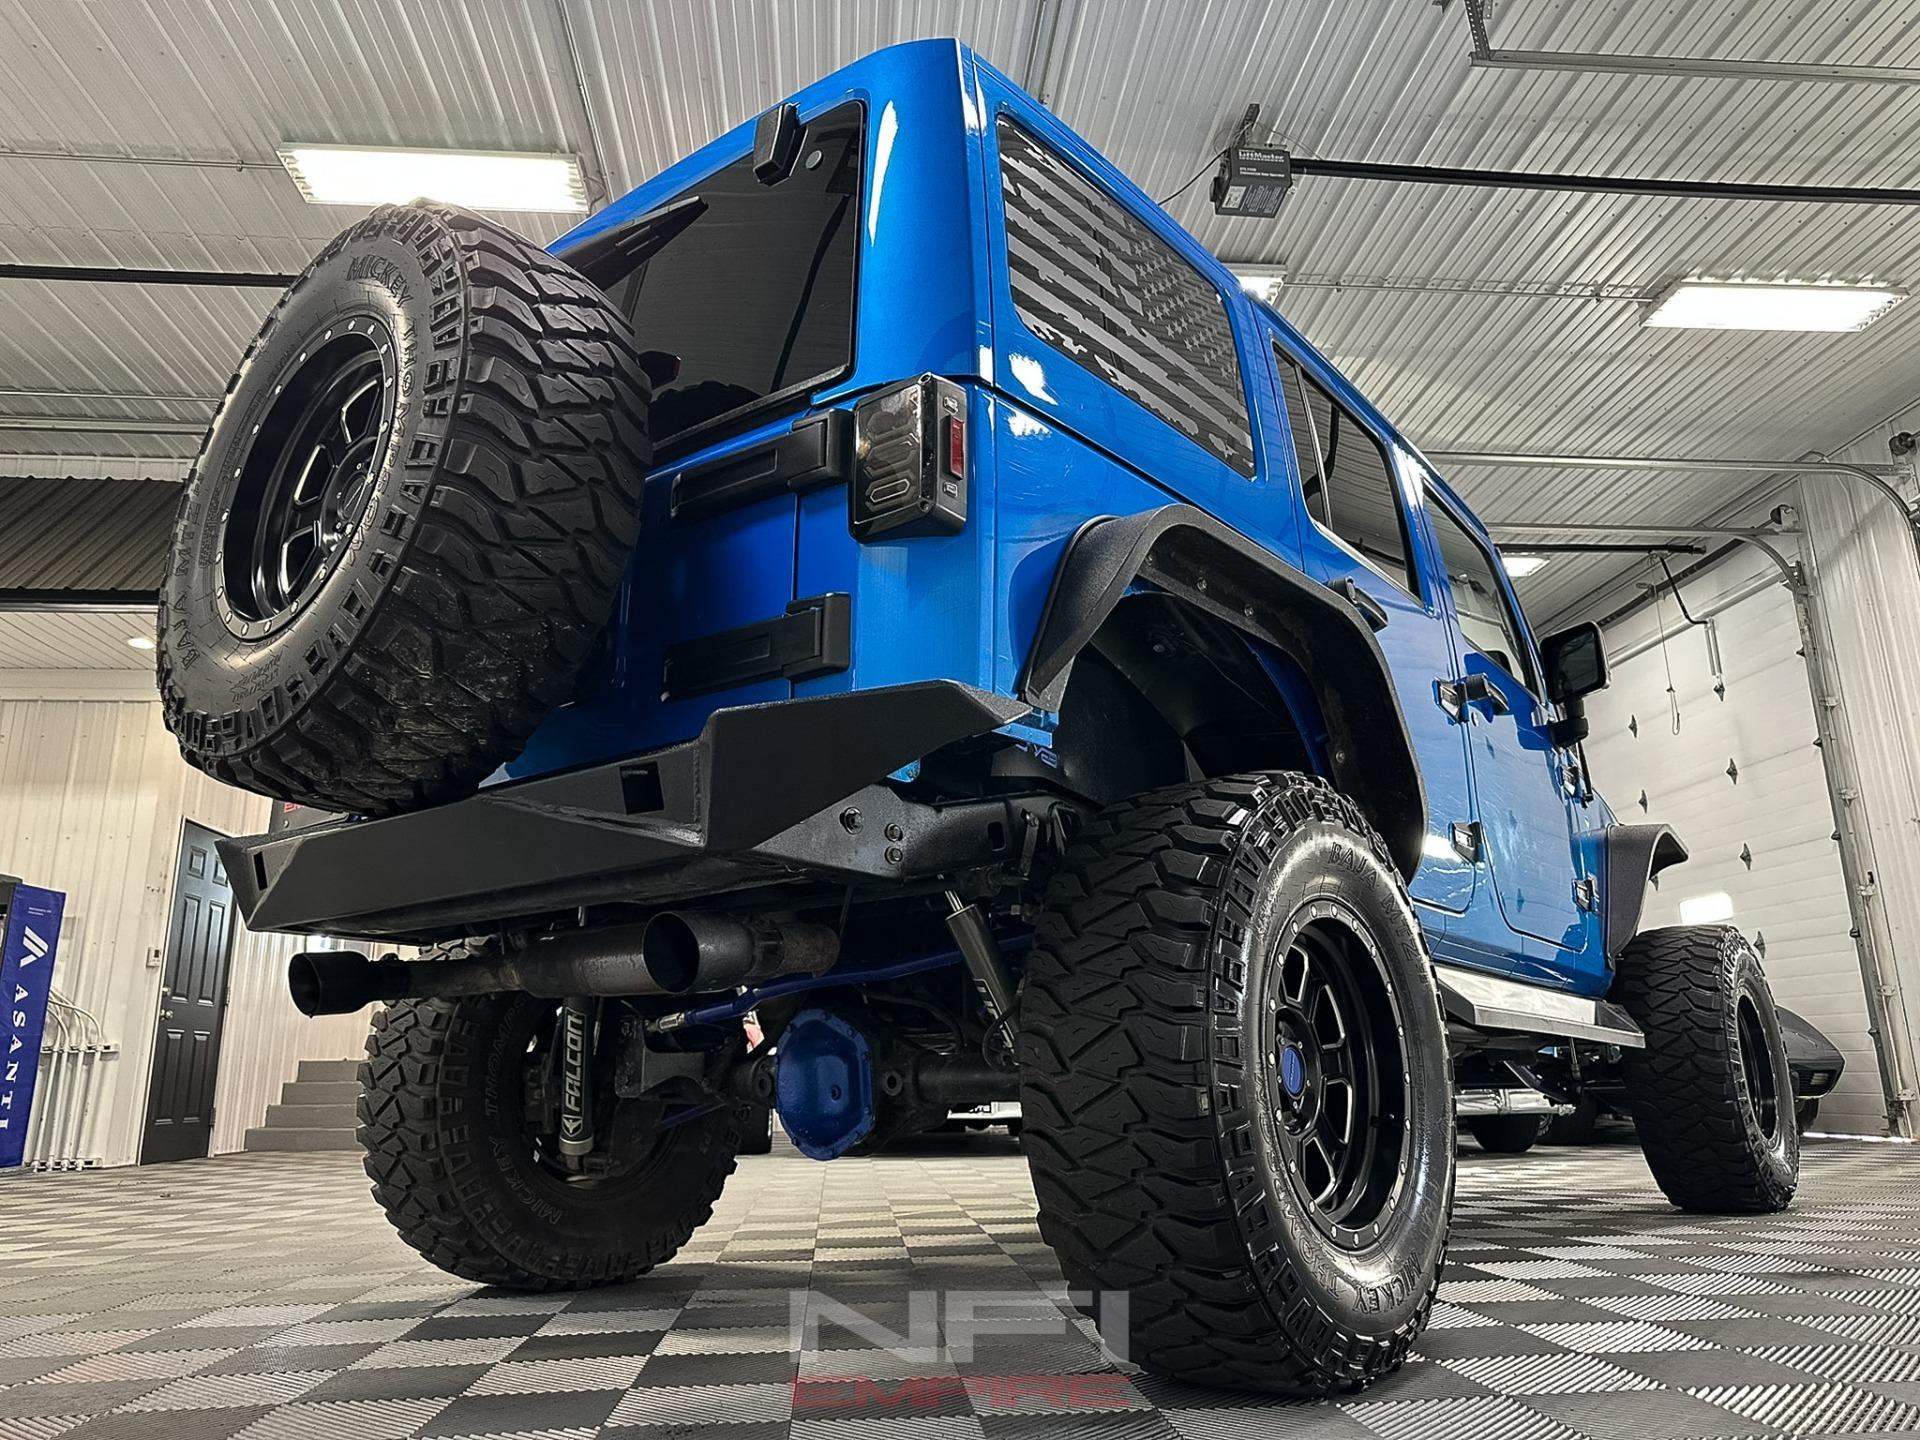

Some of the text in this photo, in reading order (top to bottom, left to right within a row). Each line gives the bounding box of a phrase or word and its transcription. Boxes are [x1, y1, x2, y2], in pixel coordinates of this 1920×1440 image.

[346, 254, 414, 308] MICKEY
[173, 587, 202, 671] BAJA
[1328, 841, 1378, 892] BAJA
[0, 983, 29, 1130] ASANTI
[563, 1012, 584, 1113] FALCON
[484, 992, 564, 1225] MICKEY THOMPS
[1352, 1251, 1421, 1315] MICKEY
